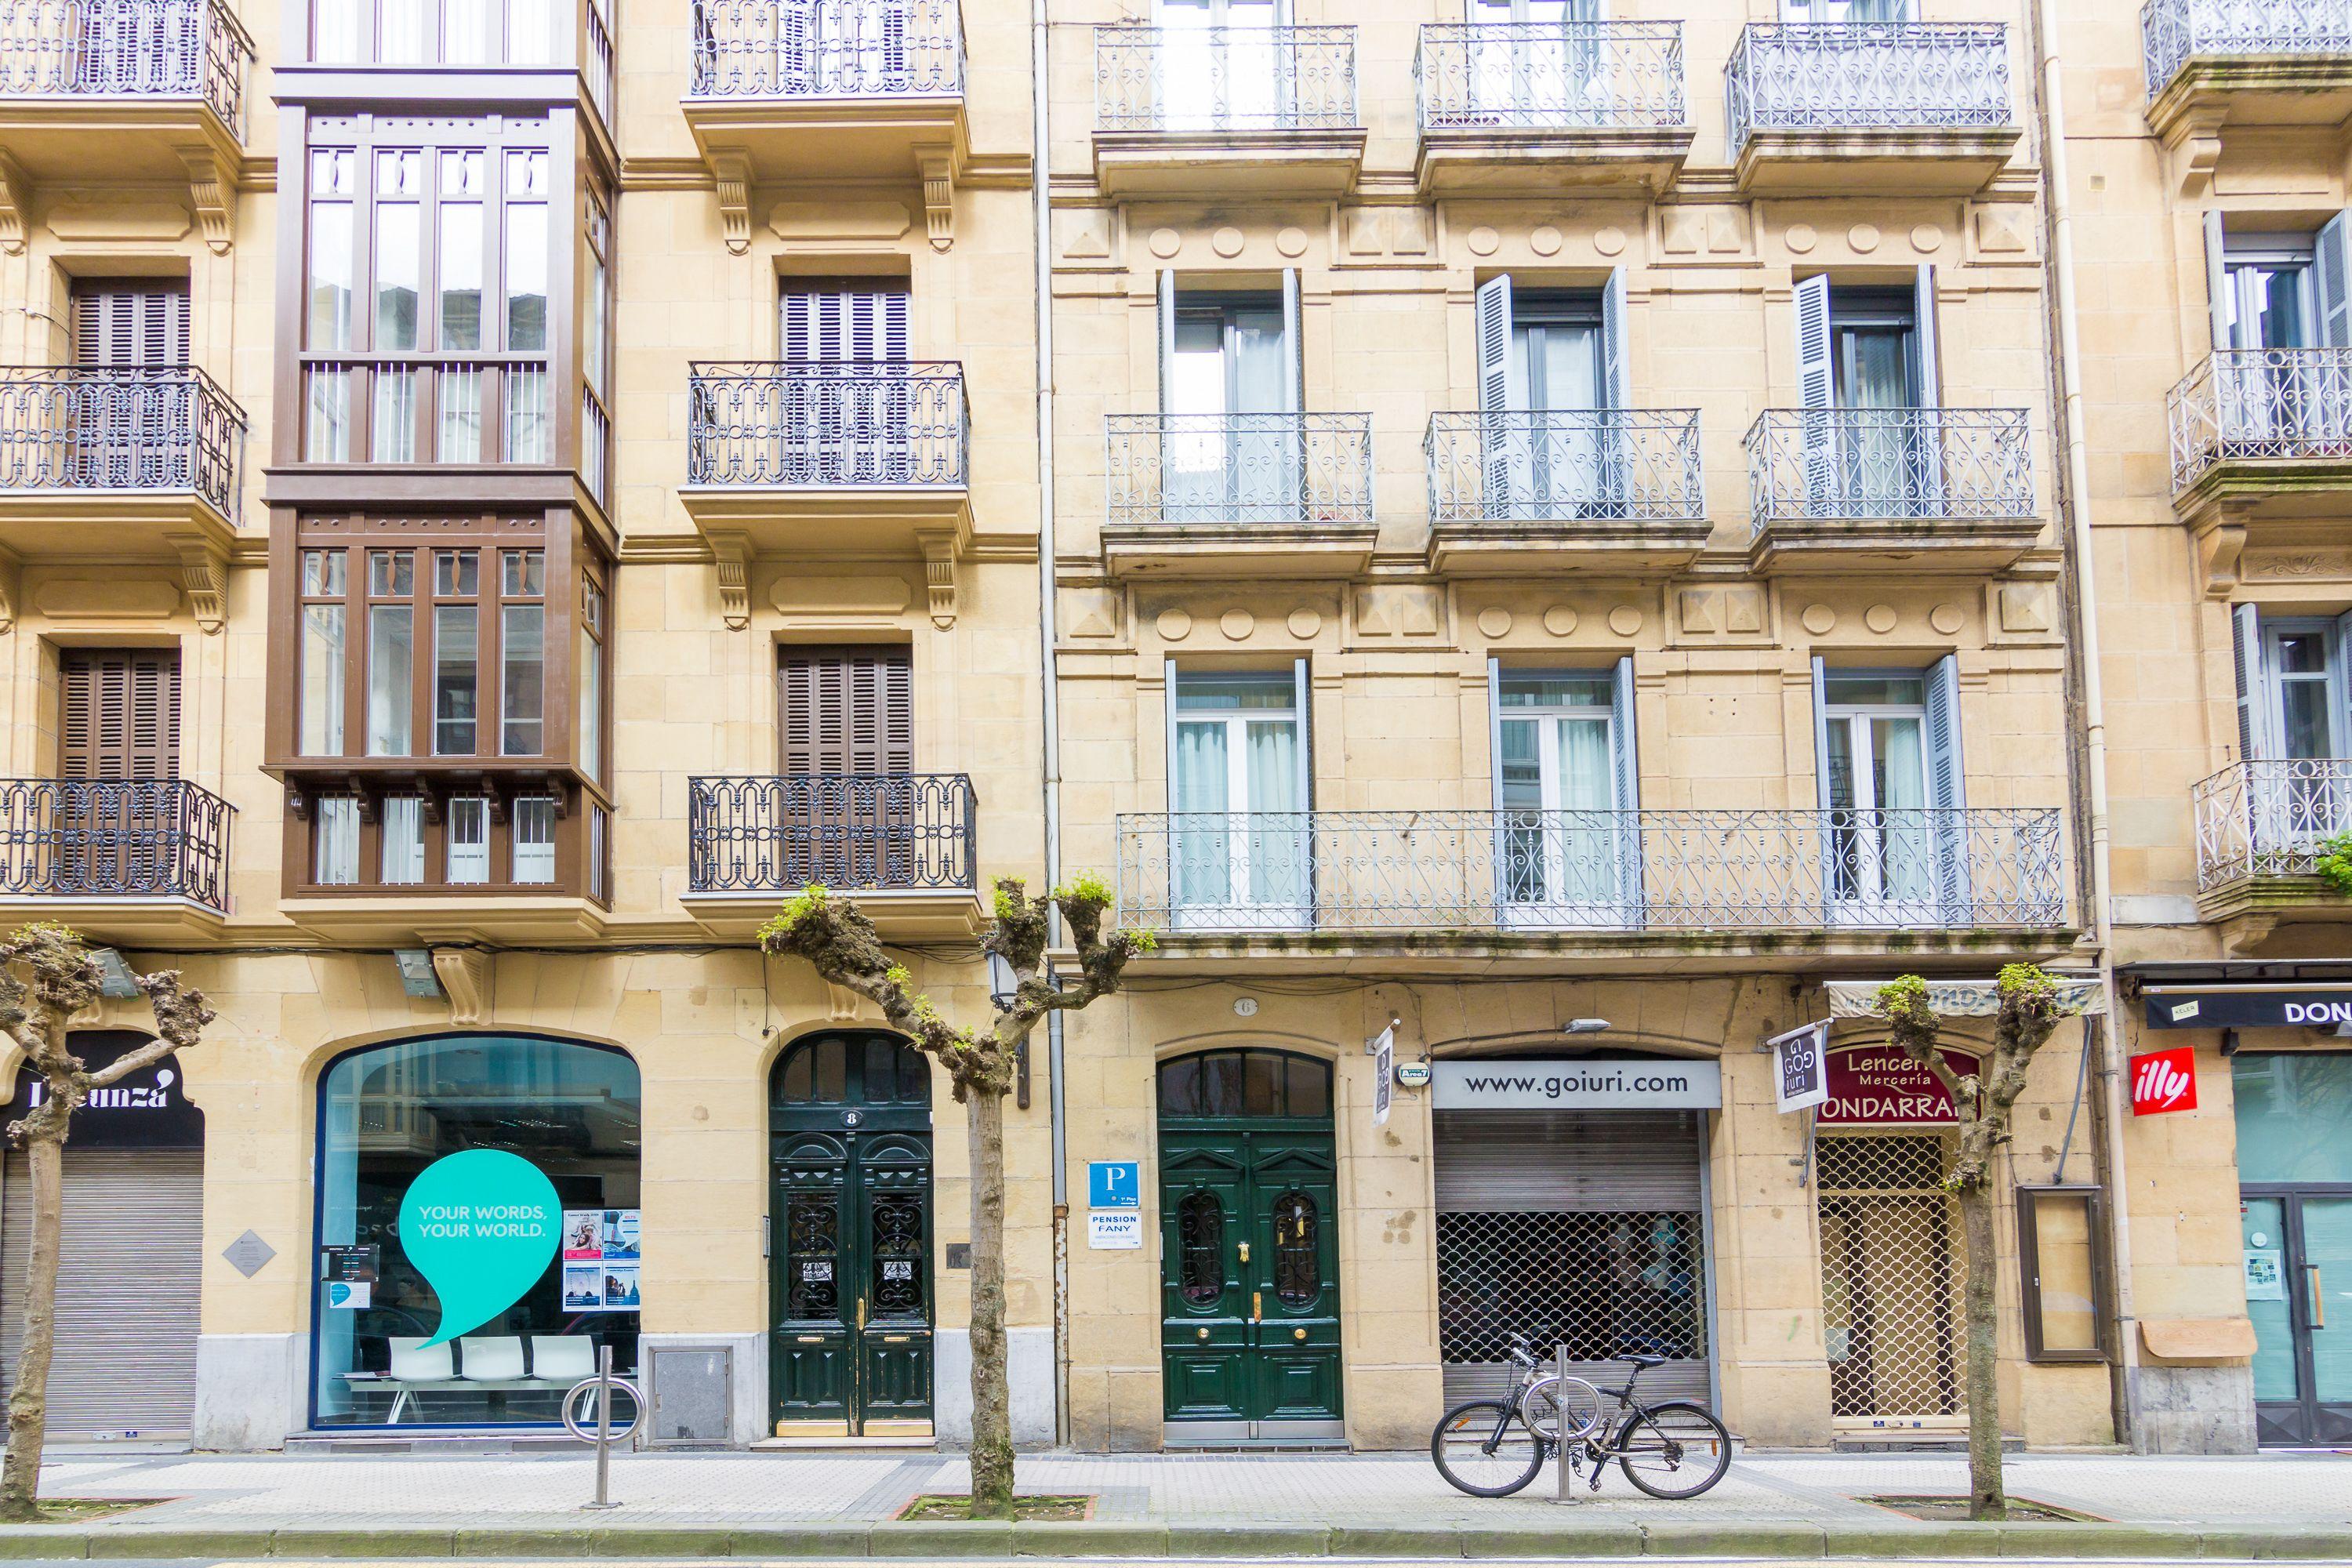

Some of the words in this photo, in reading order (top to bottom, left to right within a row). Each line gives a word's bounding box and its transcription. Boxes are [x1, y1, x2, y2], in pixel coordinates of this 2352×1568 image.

[1242, 1001, 1250, 1012] 6
[2175, 1005, 2194, 1014] KELER
[1848, 1054, 1929, 1072] Lencer
[1465, 1070, 1688, 1099] www.goiuri.com
[1786, 1071, 1805, 1091] iuri
[1860, 1074, 1931, 1085] Mercería
[2135, 1060, 2189, 1108] illy
[29, 1081, 168, 1108] Lunza
[1821, 1097, 1958, 1118] ONDARRA
[847, 1112, 857, 1124] 8
[1105, 1167, 1126, 1190] P
[419, 1206, 470, 1220] YOUR
[475, 1206, 547, 1220] WORDS,
[419, 1224, 470, 1237] YOUR
[475, 1224, 546, 1237] WORLD.
